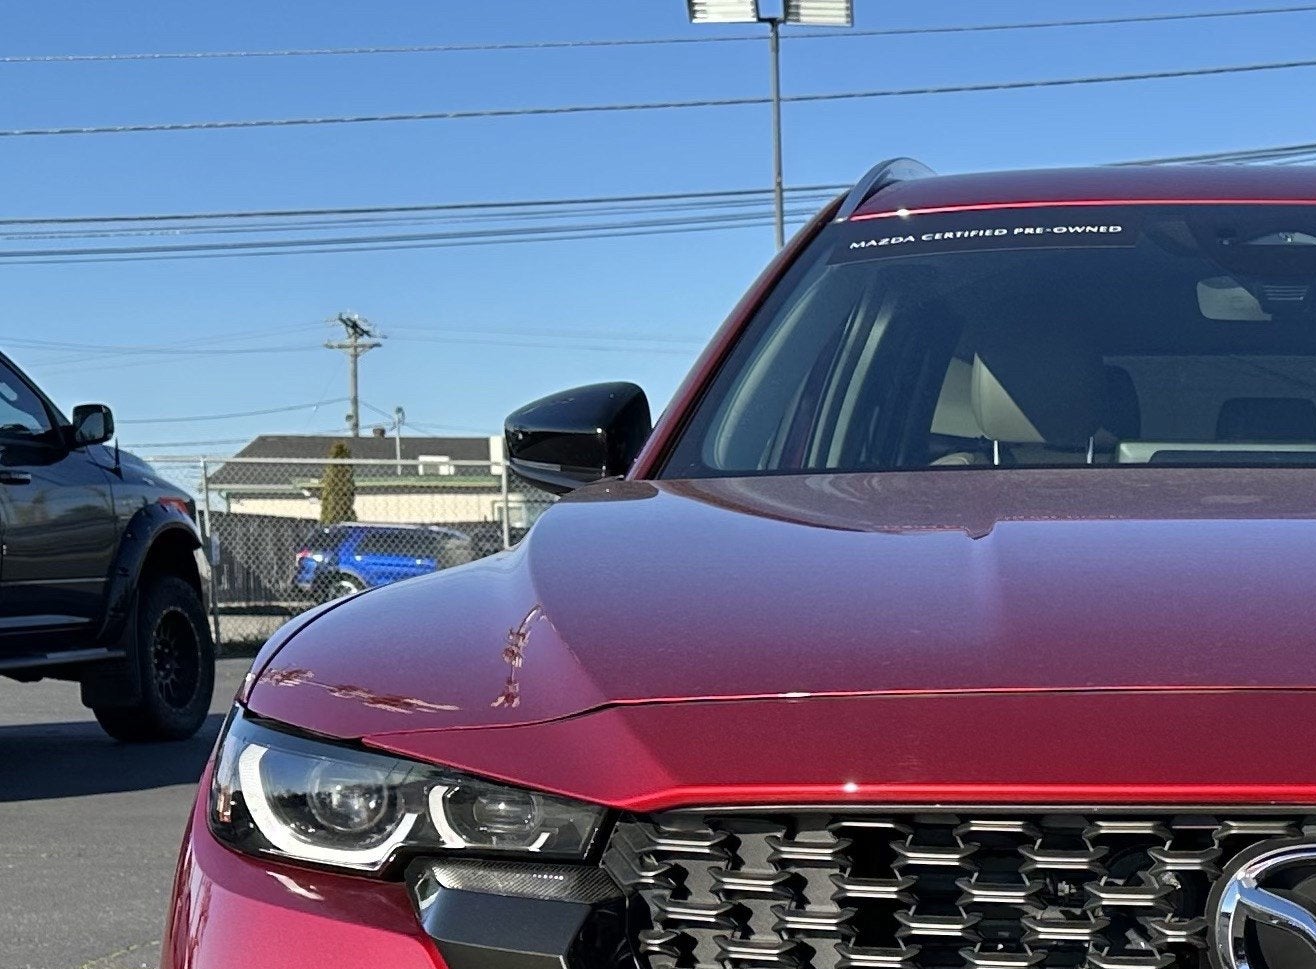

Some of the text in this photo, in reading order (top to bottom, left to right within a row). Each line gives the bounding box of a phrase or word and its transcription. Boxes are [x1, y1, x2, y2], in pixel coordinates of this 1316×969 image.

[850, 225, 1122, 249] MAZDA CERTIFIED PRE-OWNED
